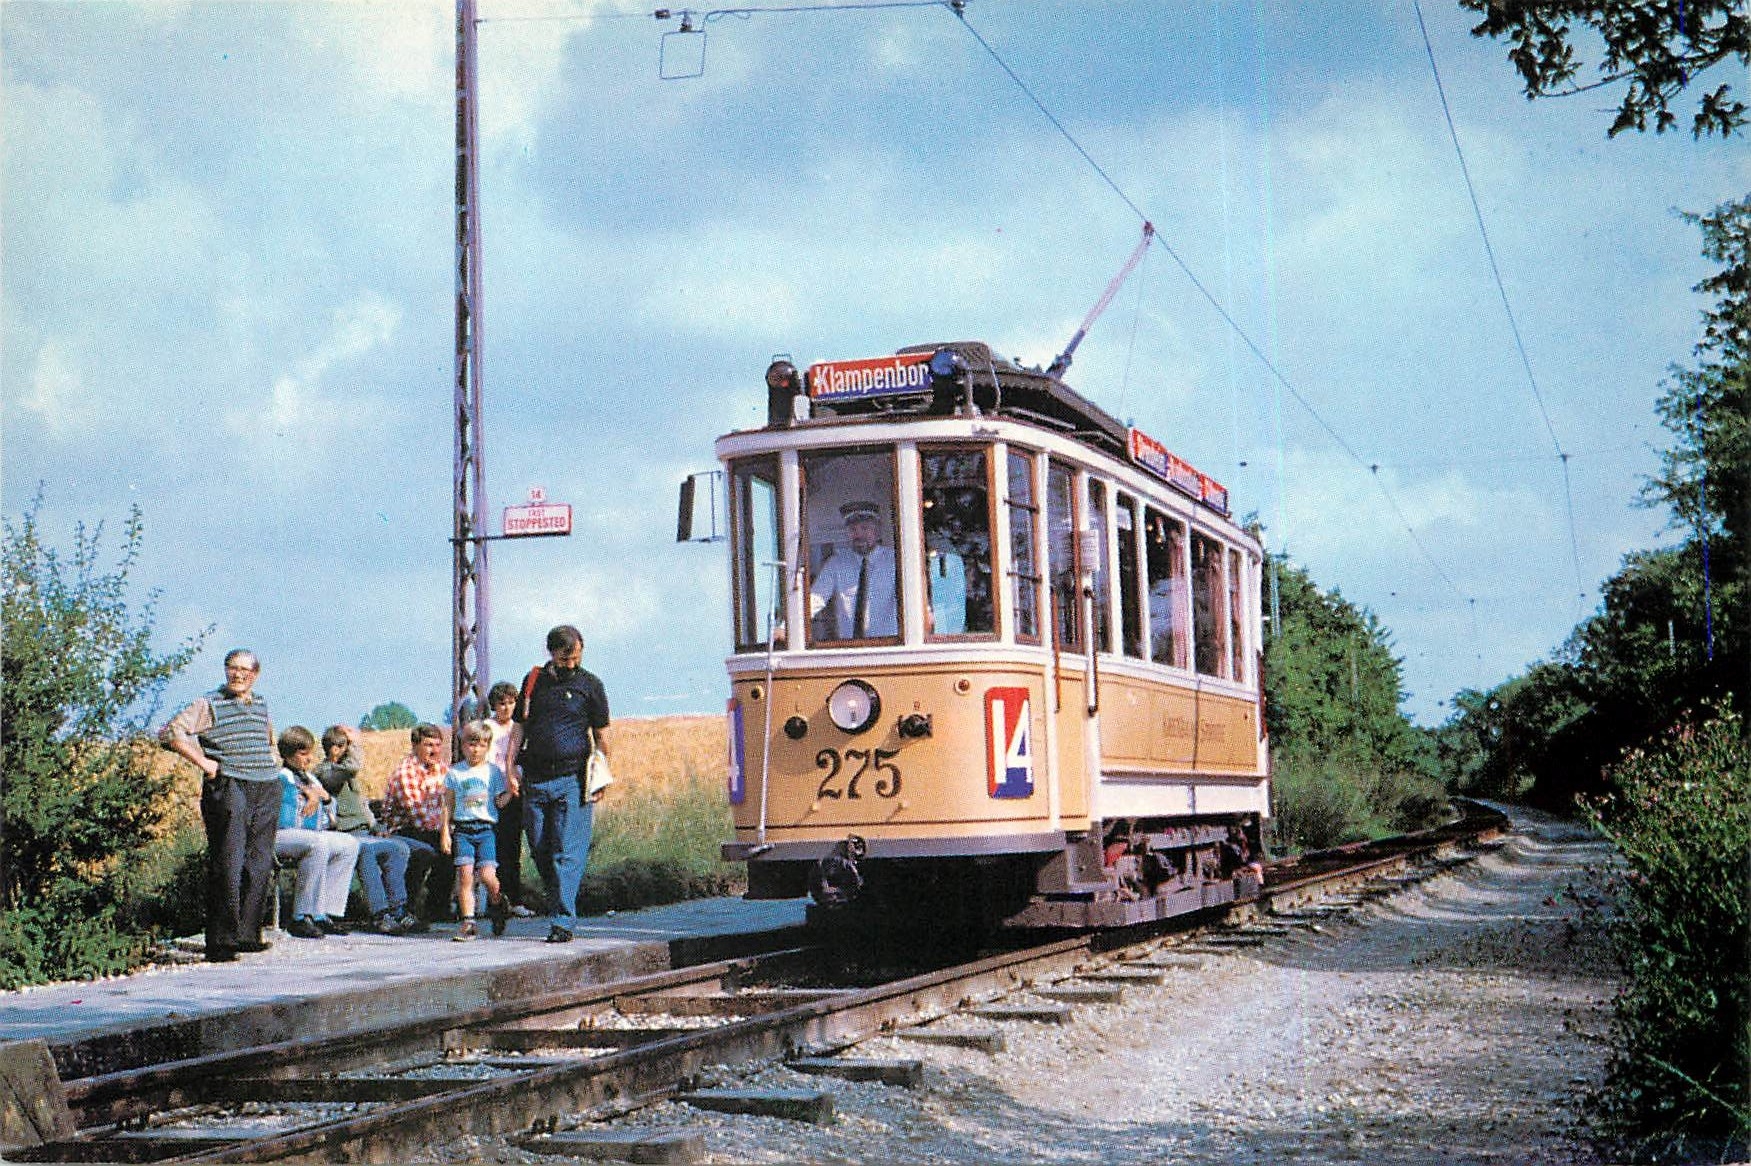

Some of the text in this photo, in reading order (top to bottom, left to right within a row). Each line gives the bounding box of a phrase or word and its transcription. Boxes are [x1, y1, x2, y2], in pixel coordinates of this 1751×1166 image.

[814, 361, 934, 395] Klampenbor
[992, 699, 1033, 784] 14
[816, 748, 902, 799] 275
